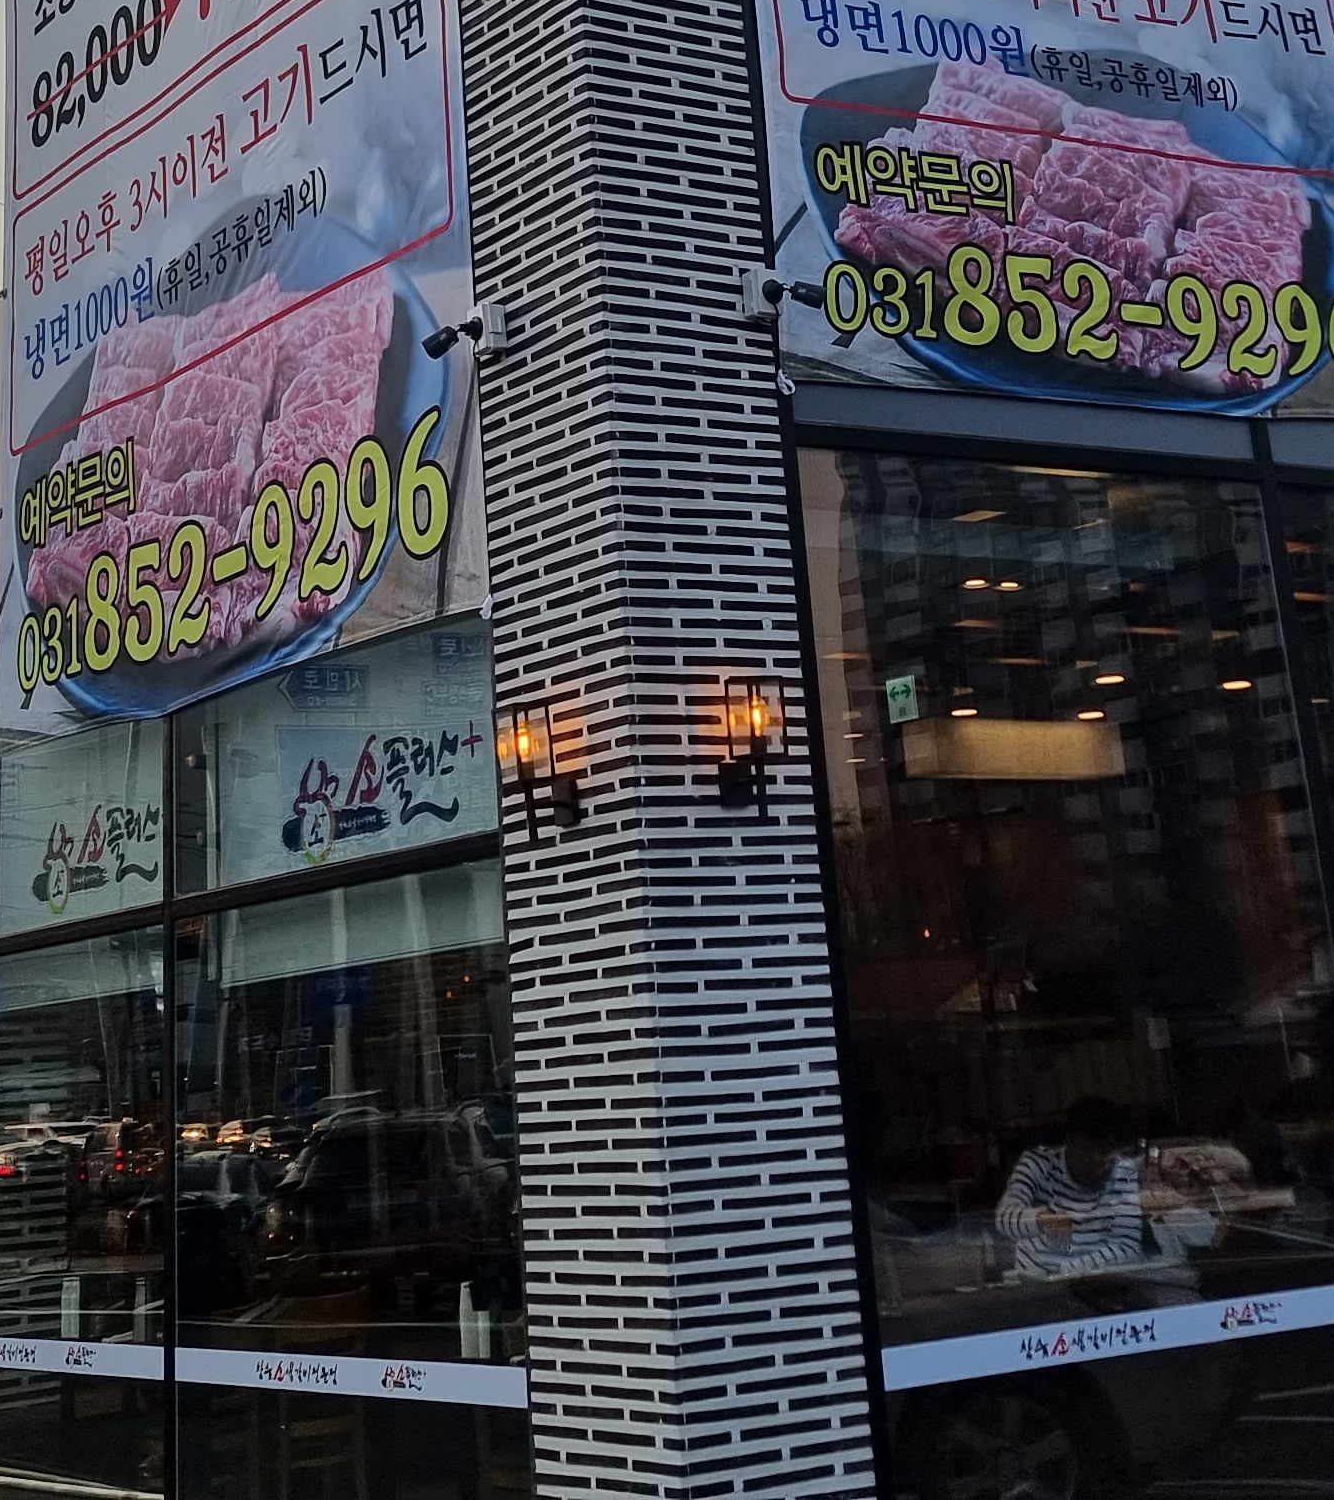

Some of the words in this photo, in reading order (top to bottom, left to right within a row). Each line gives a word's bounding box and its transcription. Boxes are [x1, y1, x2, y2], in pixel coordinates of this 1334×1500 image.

[23, 190, 121, 297] 평일오후
[128, 110, 229, 235] 3시이전
[815, 143, 1016, 223] 예약문의
[19, 437, 138, 550] 예약문의
